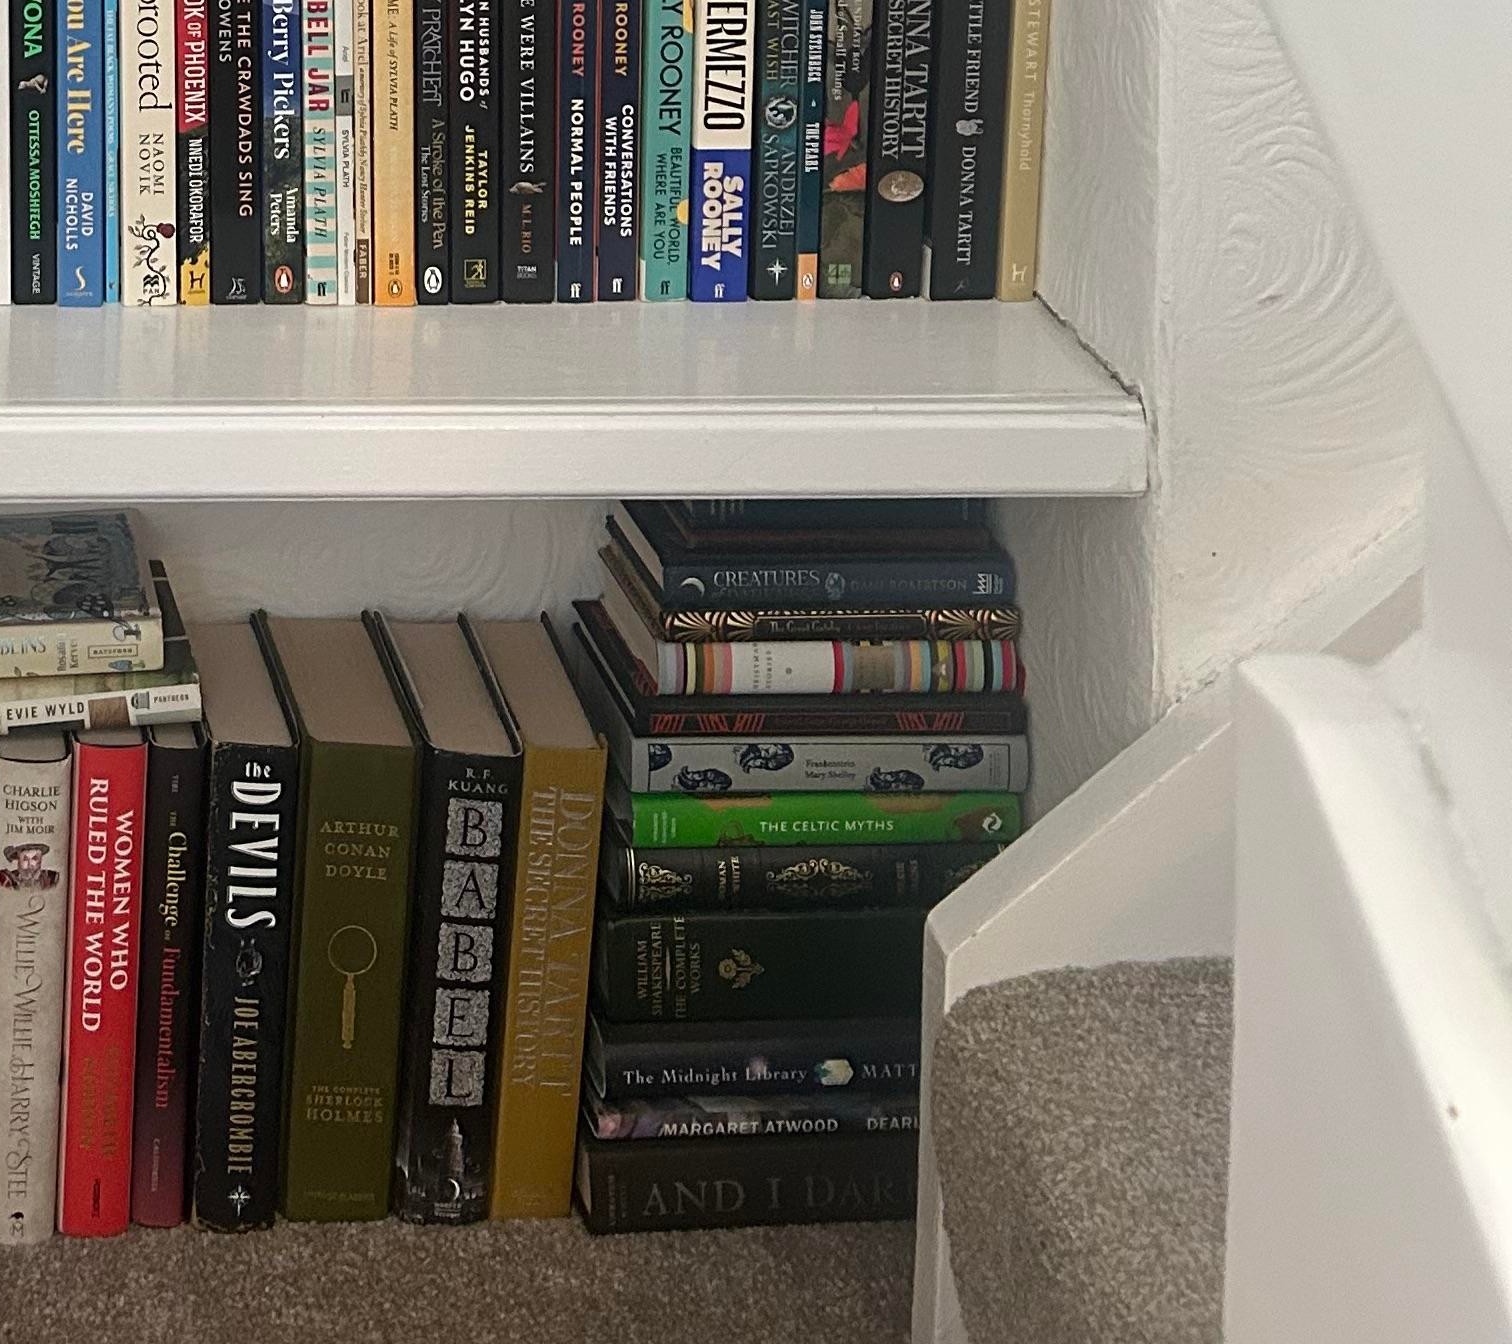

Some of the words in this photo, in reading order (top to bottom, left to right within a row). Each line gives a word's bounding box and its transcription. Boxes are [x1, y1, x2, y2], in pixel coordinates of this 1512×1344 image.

[307, 1, 329, 57] BELL
[67, 36, 90, 83] Are
[459, 35, 473, 102] HUGO
[309, 68, 328, 111] JAR
[67, 89, 91, 153] Here
[702, 162, 722, 271] ROONEY
[722, 176, 742, 258] SALLY
[713, 570, 820, 587] CREATURES
[6, 706, 39, 720] EVIE
[46, 701, 85, 717] WYLD
[88, 777, 108, 865] RULED
[320, 821, 399, 838] ARTHUR
[760, 822, 788, 833] THE
[793, 820, 840, 832] CELTIC
[846, 819, 894, 832] MYTHS
[115, 810, 134, 915] WOMEN
[226, 780, 281, 929] DEVILS
[324, 844, 390, 858] CONAN
[326, 864, 387, 880] DOYLE
[85, 872, 105, 925] THE
[111, 922, 130, 990] WHO
[444, 807, 488, 1100] BABEL
[81, 933, 103, 1032] WORLD
[233, 997, 257, 1031] JOE
[624, 1071, 654, 1084] The
[661, 1068, 738, 1083] Midnight
[746, 1067, 808, 1082] Library
[227, 1036, 257, 1175] ABERCROMBIE
